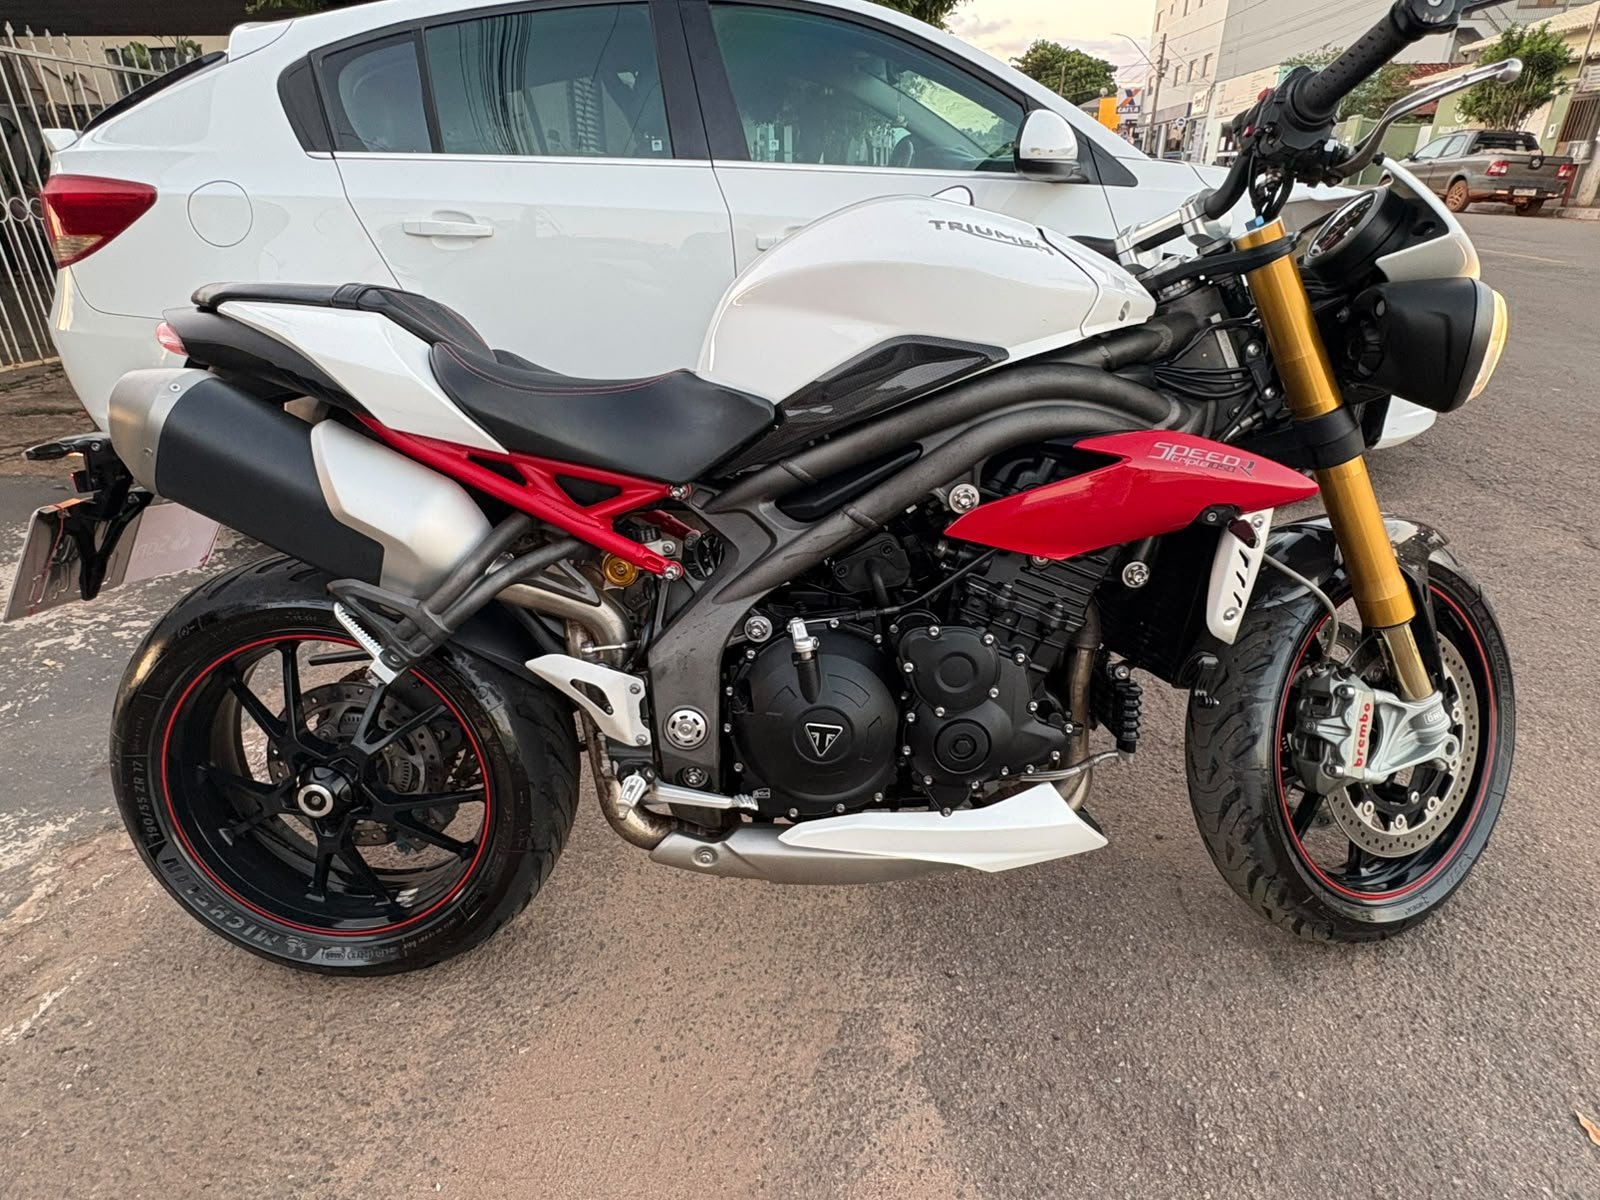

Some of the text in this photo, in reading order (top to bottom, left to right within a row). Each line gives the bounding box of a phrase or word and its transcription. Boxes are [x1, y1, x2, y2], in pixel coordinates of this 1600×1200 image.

[928, 219, 1054, 256] TRIUMPH
[1147, 442, 1241, 467] SPEED
[1353, 703, 1371, 768] brembo
[132, 760, 145, 773] 17
[133, 776, 146, 793] ZR
[136, 796, 160, 839] 190/55
[162, 856, 280, 947] MICHELIN
